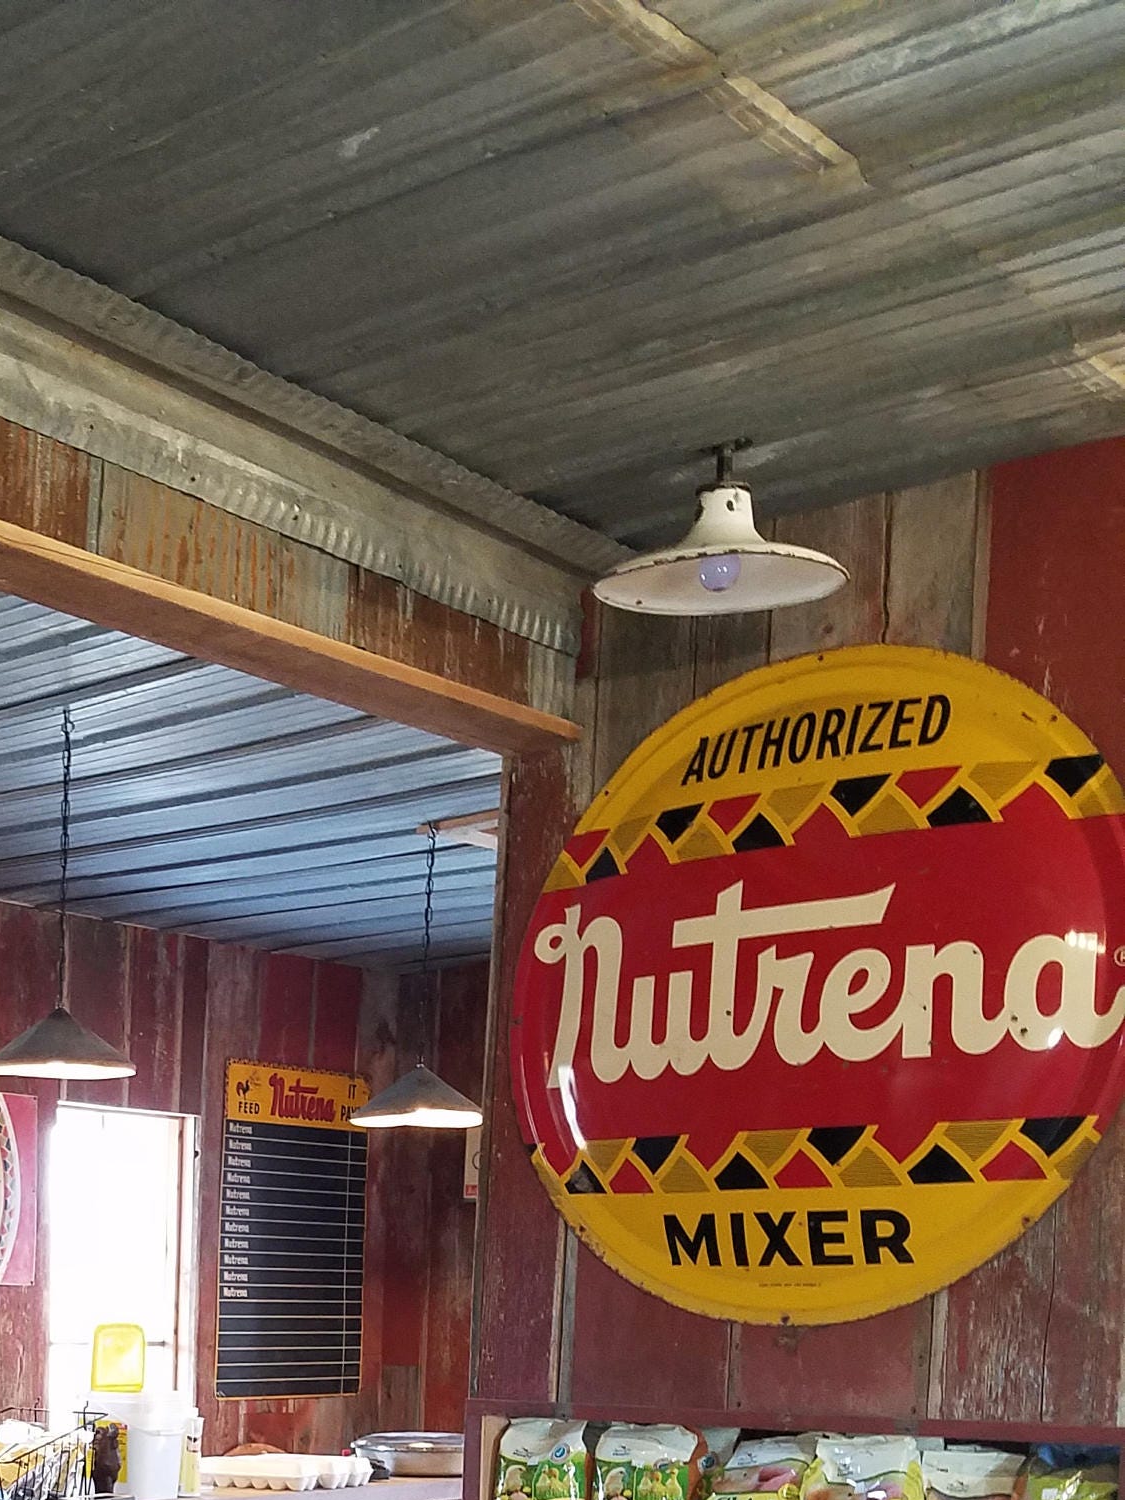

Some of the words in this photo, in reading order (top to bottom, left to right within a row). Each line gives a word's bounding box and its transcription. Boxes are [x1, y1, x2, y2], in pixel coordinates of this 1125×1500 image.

[682, 694, 951, 786] AUTHORIZED
[533, 880, 1125, 1089] Nutrena
[238, 1101, 260, 1115] FEED
[268, 1072, 337, 1123] Nutrena
[348, 1084, 357, 1099] IT
[663, 1210, 915, 1268] MIXER
